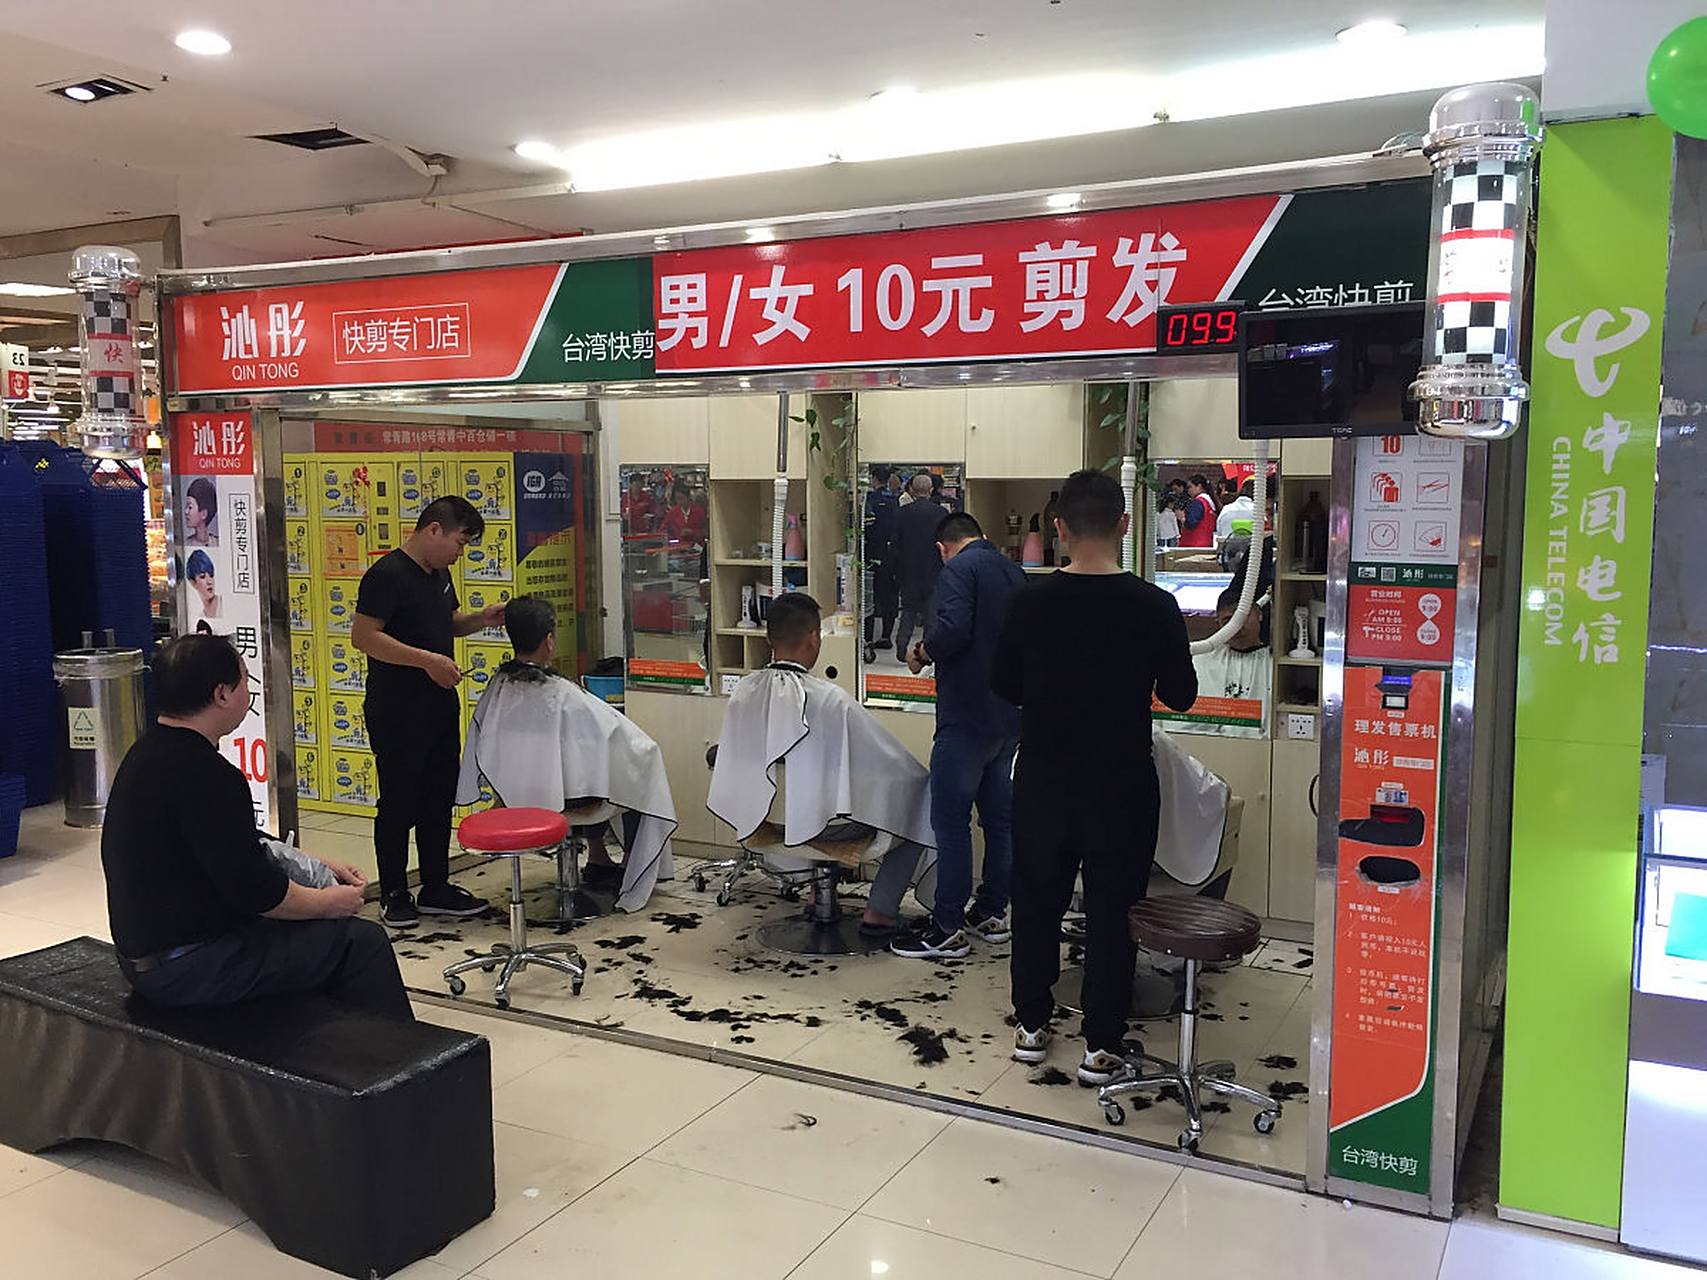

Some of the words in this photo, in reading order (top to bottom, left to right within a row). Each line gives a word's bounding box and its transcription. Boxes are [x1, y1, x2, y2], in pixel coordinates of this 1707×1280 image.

[656, 263, 814, 353] 男/女
[837, 253, 996, 337] 10元
[1017, 231, 1189, 332] 剪发
[220, 301, 307, 361] 沁彤
[341, 313, 461, 355] 快剪专门店
[562, 329, 655, 362] 台湾快剪
[231, 364, 256, 381] QIN
[259, 362, 299, 379] TONG
[192, 419, 245, 456] 沁彤
[1381, 433, 1401, 454] 10
[198, 457, 215, 469] QIN
[216, 456, 242, 469] TONG
[1548, 436, 1572, 520] CHINA
[233, 498, 250, 589] 快剪专门店
[1571, 412, 1632, 665] 中国电信
[1543, 525, 1568, 646] TELECOM
[1372, 616, 1386, 624] AM
[1375, 626, 1401, 634] CLOSE
[1377, 608, 1401, 617] OPEN
[1354, 718, 1437, 739] 理发售票机
[232, 737, 267, 784] 10
[1342, 1145, 1418, 1176] 台湾快剪
